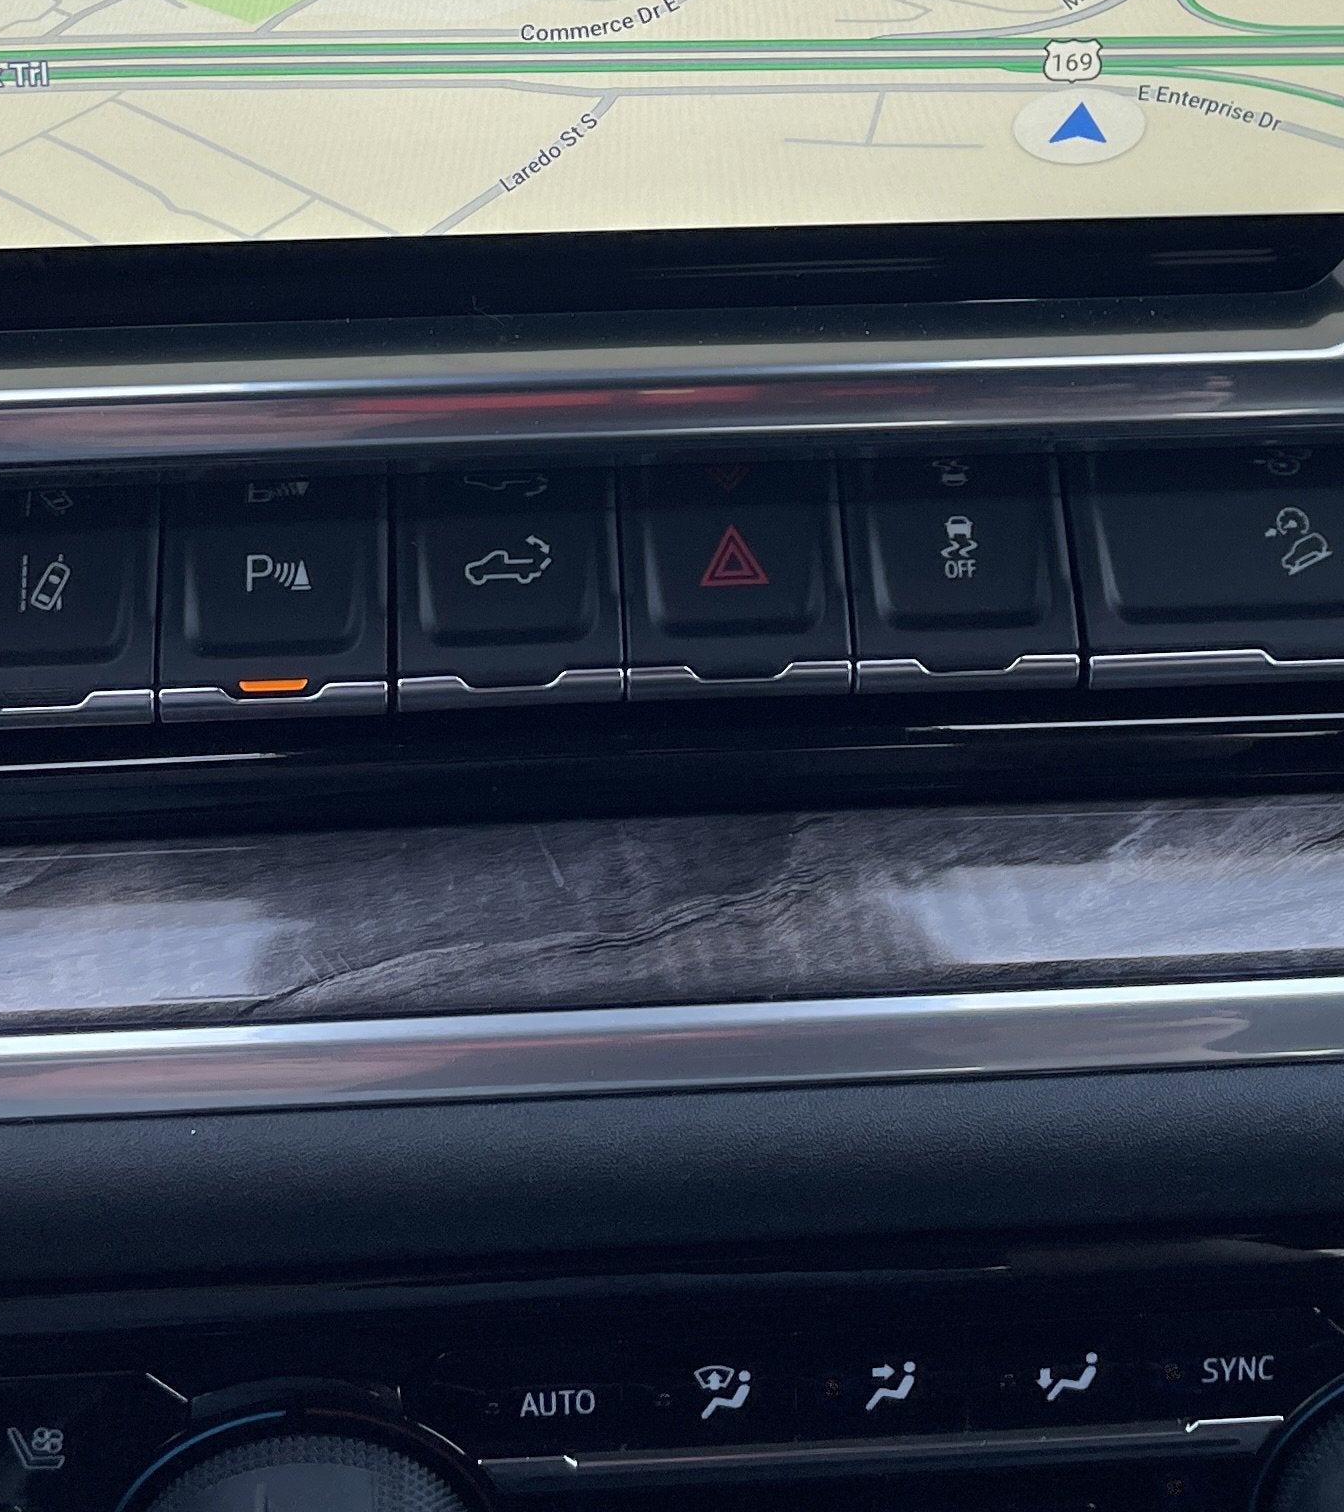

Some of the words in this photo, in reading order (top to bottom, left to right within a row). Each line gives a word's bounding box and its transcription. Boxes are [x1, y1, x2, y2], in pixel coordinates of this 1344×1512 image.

[520, 13, 634, 41] Commerce
[637, 5, 663, 25] Dr
[8, 61, 50, 88] Trl
[1051, 53, 1093, 73] 169
[1138, 85, 1151, 101] E
[1156, 86, 1254, 123] Enterprise
[1258, 113, 1282, 132] Dr
[499, 144, 562, 193] Laredo
[560, 126, 584, 148] St
[580, 112, 598, 131] S
[945, 559, 976, 578] OFF
[1202, 1356, 1275, 1383] SYNC
[520, 1390, 596, 1418] AUTO
